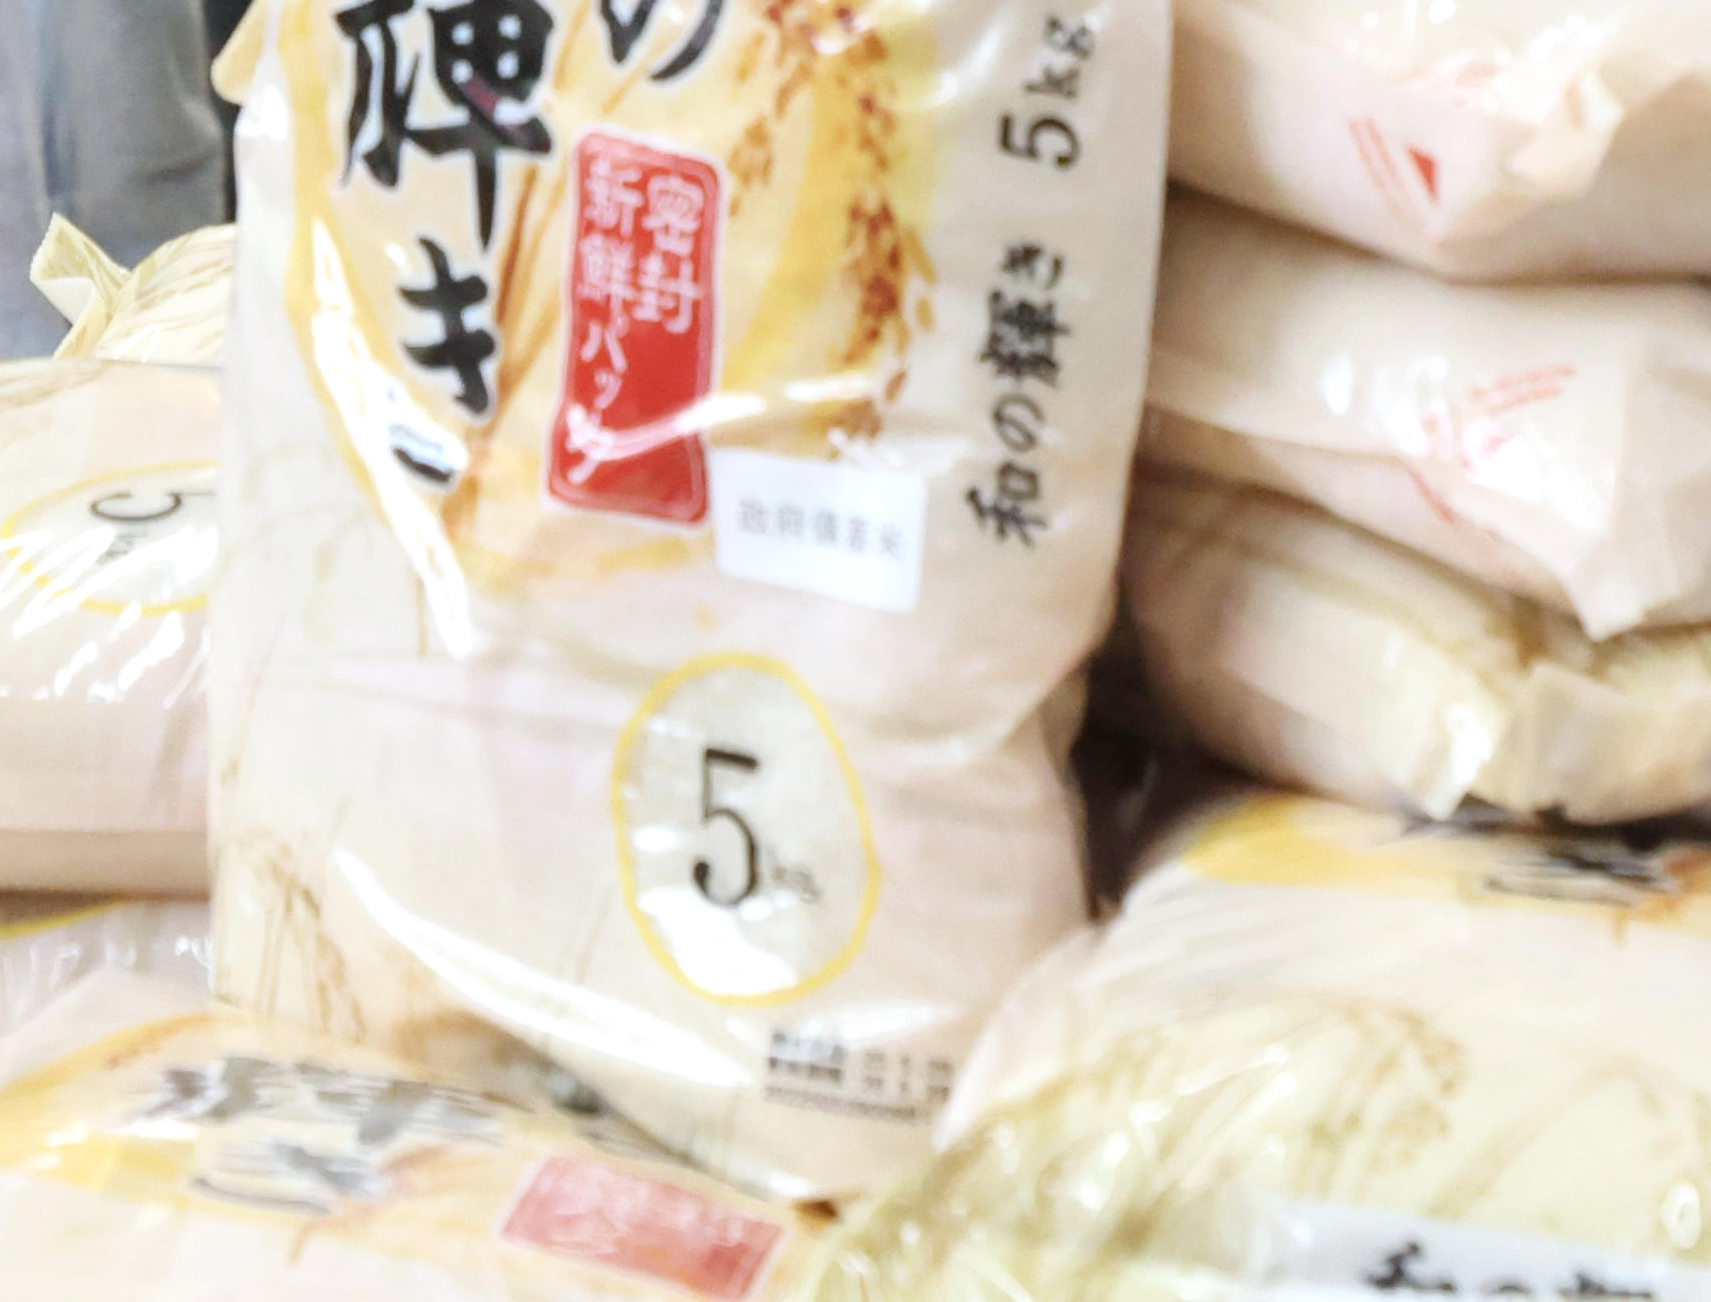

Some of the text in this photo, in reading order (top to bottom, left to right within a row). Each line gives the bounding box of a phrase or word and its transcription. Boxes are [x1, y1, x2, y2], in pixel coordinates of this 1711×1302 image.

[999, 16, 1094, 170] 5kg
[641, 175, 706, 334] 密封
[966, 243, 1070, 547] 和の輝き
